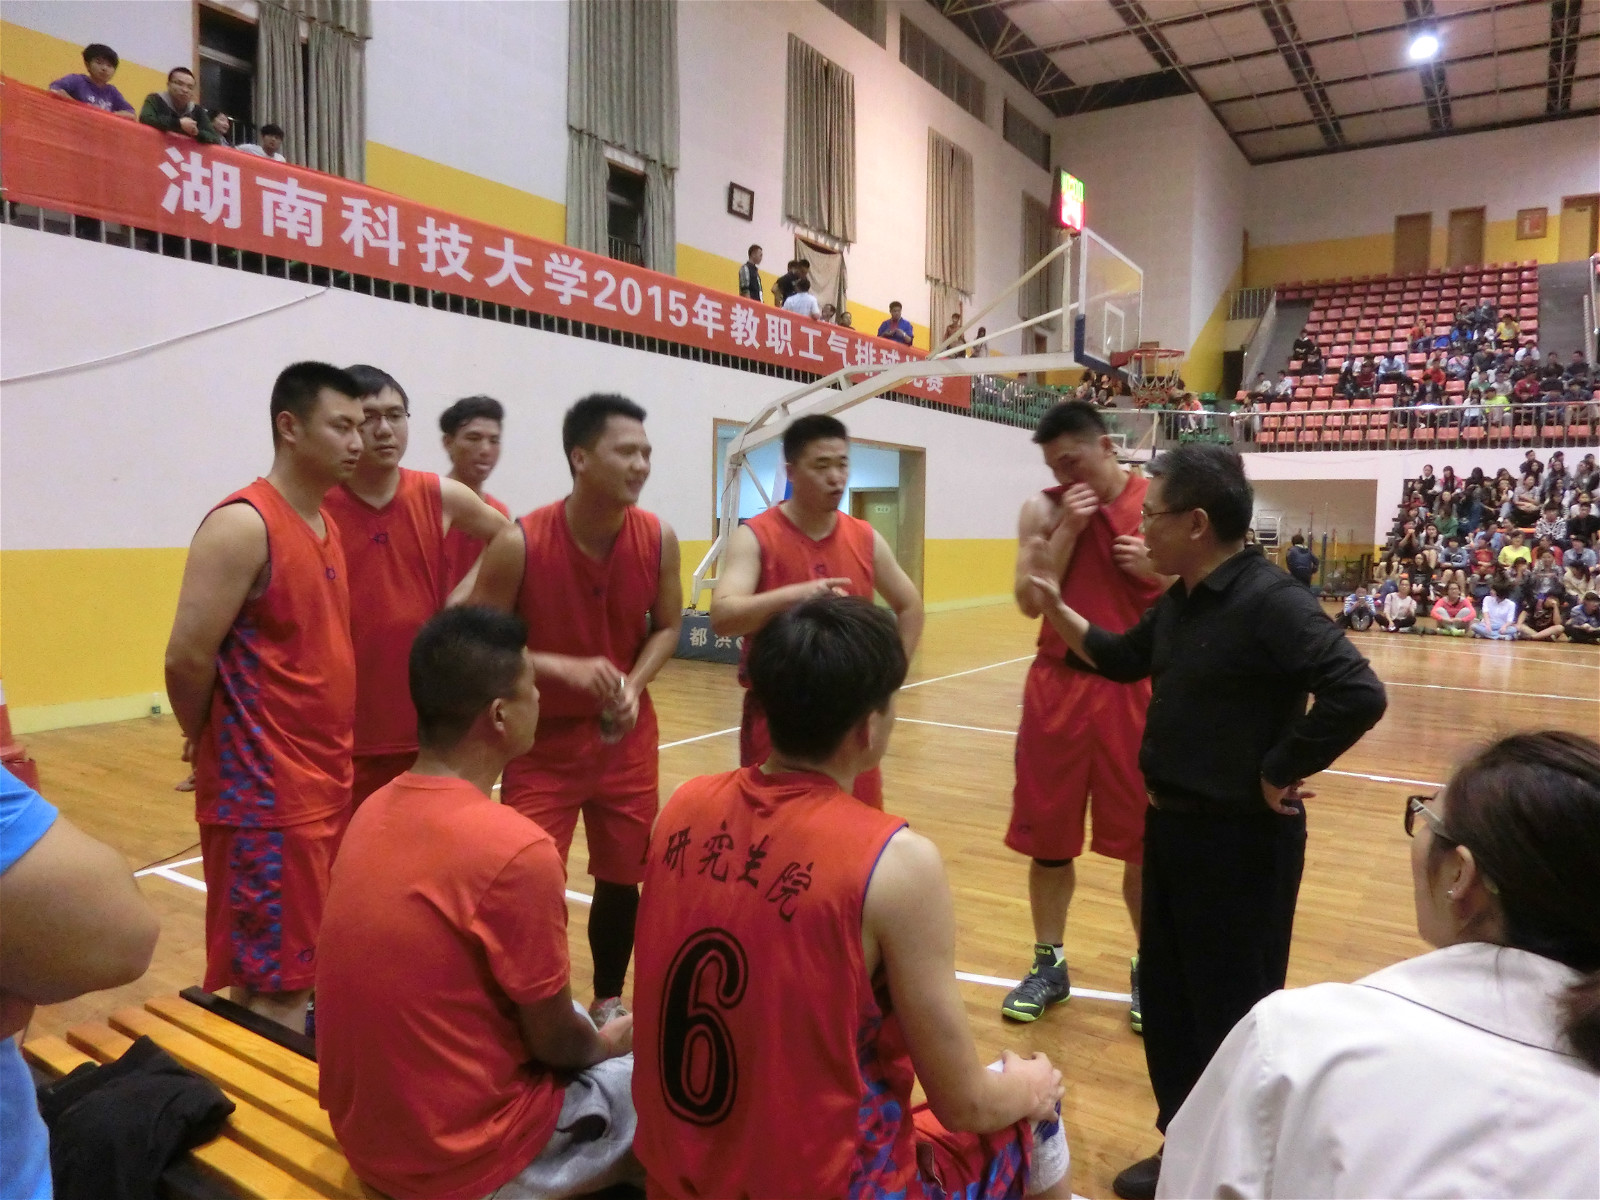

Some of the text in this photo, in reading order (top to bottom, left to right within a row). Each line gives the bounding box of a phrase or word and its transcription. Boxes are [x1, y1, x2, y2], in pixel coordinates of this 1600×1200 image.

[662, 820, 814, 923] 研究生院
[659, 926, 748, 1127] 6
